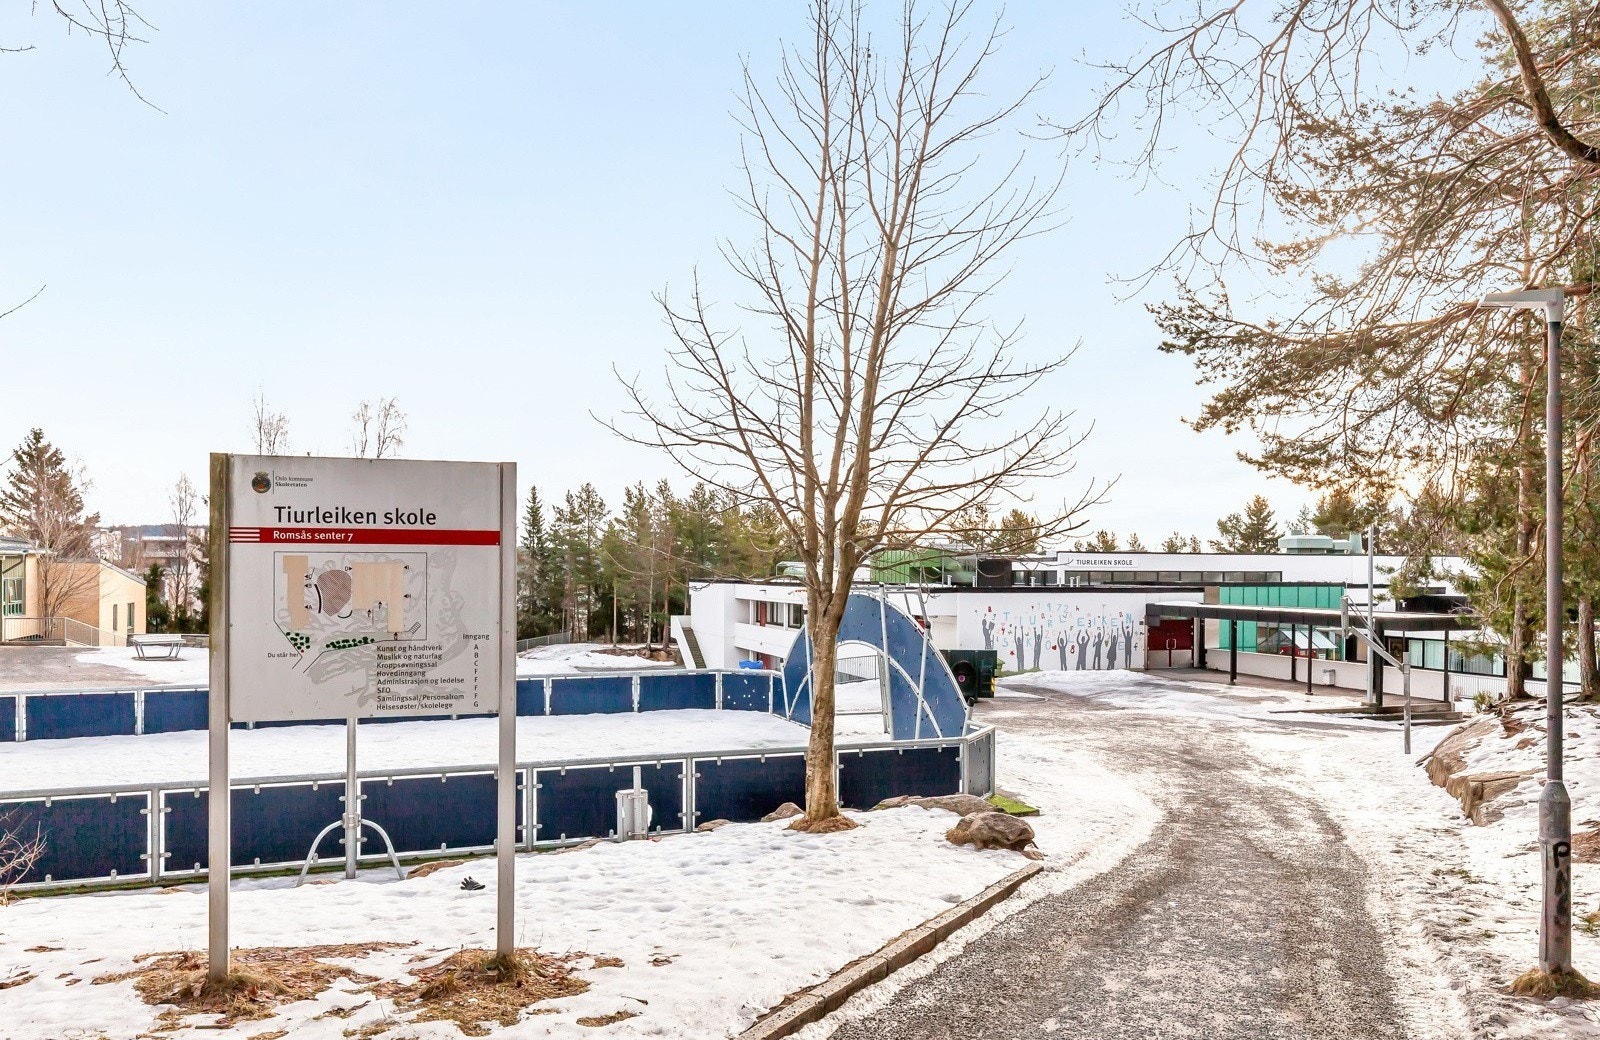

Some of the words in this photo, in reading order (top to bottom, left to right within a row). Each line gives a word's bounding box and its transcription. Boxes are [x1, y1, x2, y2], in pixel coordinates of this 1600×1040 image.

[274, 506, 377, 524] Tiurleiken
[384, 508, 436, 525] skole
[273, 531, 312, 540] Romsås
[315, 532, 345, 540] senter
[347, 533, 353, 542] 7
[463, 633, 490, 641] Inngang
[408, 644, 443, 652] håndtverk
[413, 653, 443, 661] naturfag
[376, 661, 438, 670] Kroppsøvningssal
[376, 670, 426, 678] Hovedinngang
[376, 678, 429, 686] Administrasjon
[377, 694, 465, 703] Samlingssal/Personalrom
[376, 702, 453, 711] Helsesøster/skolelege
